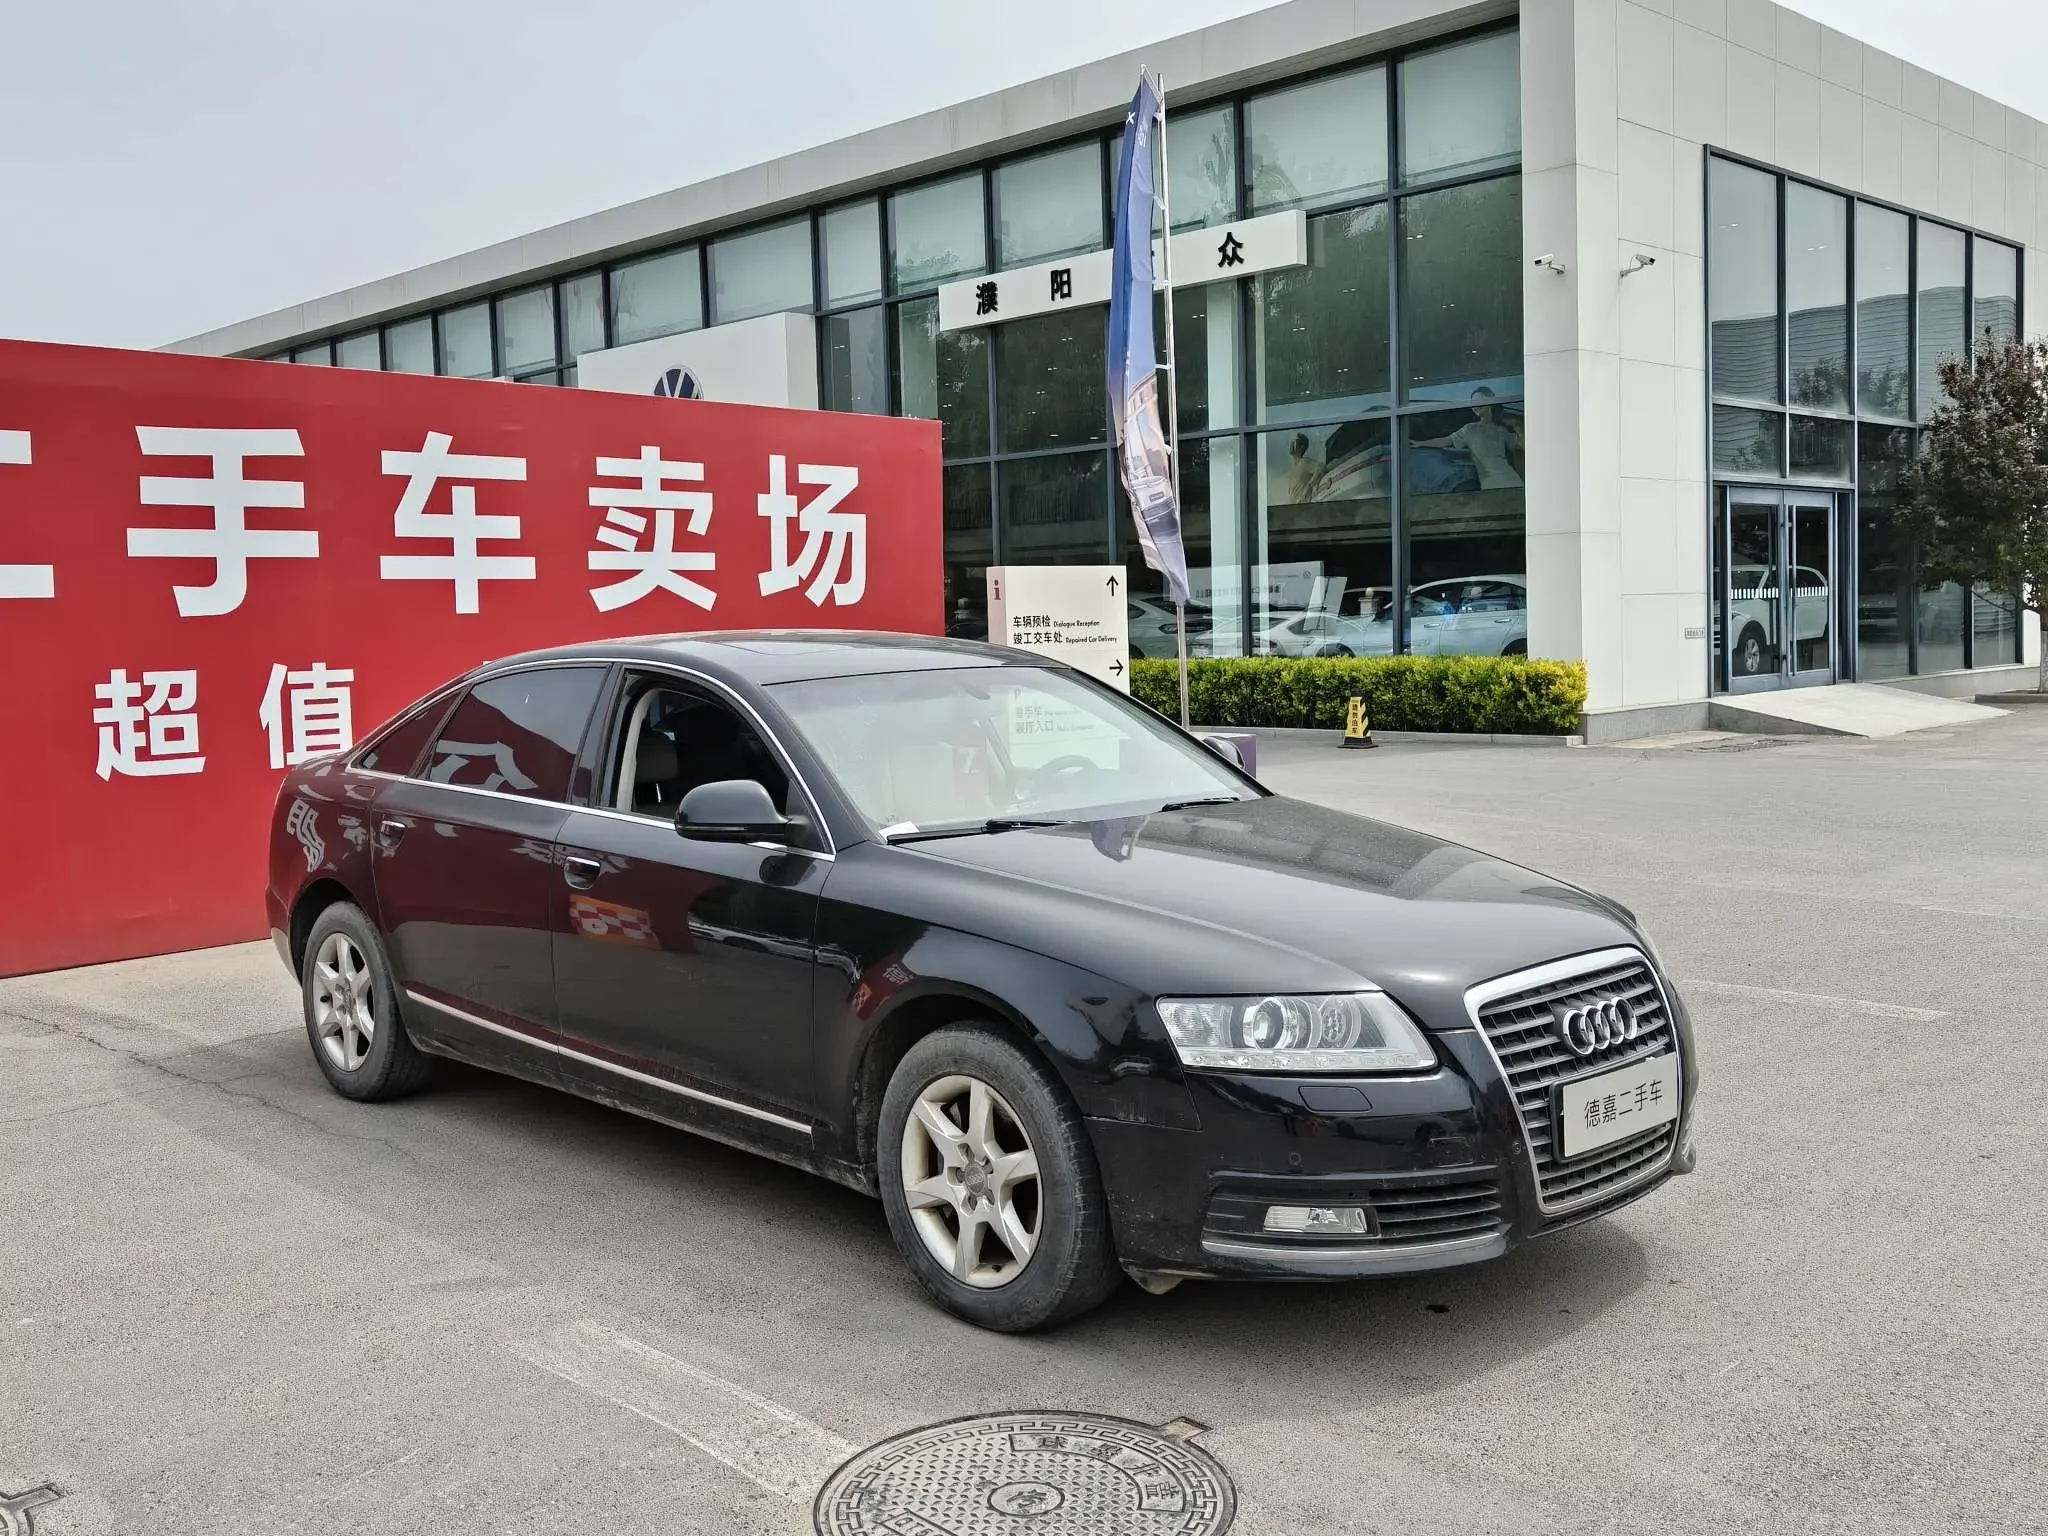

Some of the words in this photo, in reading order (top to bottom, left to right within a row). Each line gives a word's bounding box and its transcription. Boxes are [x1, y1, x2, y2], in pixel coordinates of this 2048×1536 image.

[976, 232, 1244, 316] 濮阳众
[0, 426, 868, 617] 手车卖场
[1013, 615, 1051, 628] 车辆预检
[1076, 620, 1100, 628] Reception
[1013, 631, 1063, 645] 竣工交车处
[1065, 636, 1087, 644] Repaired
[1098, 635, 1117, 643] Delivery
[93, 661, 353, 782] 超值
[1584, 1079, 1663, 1129] 德嘉二手车
